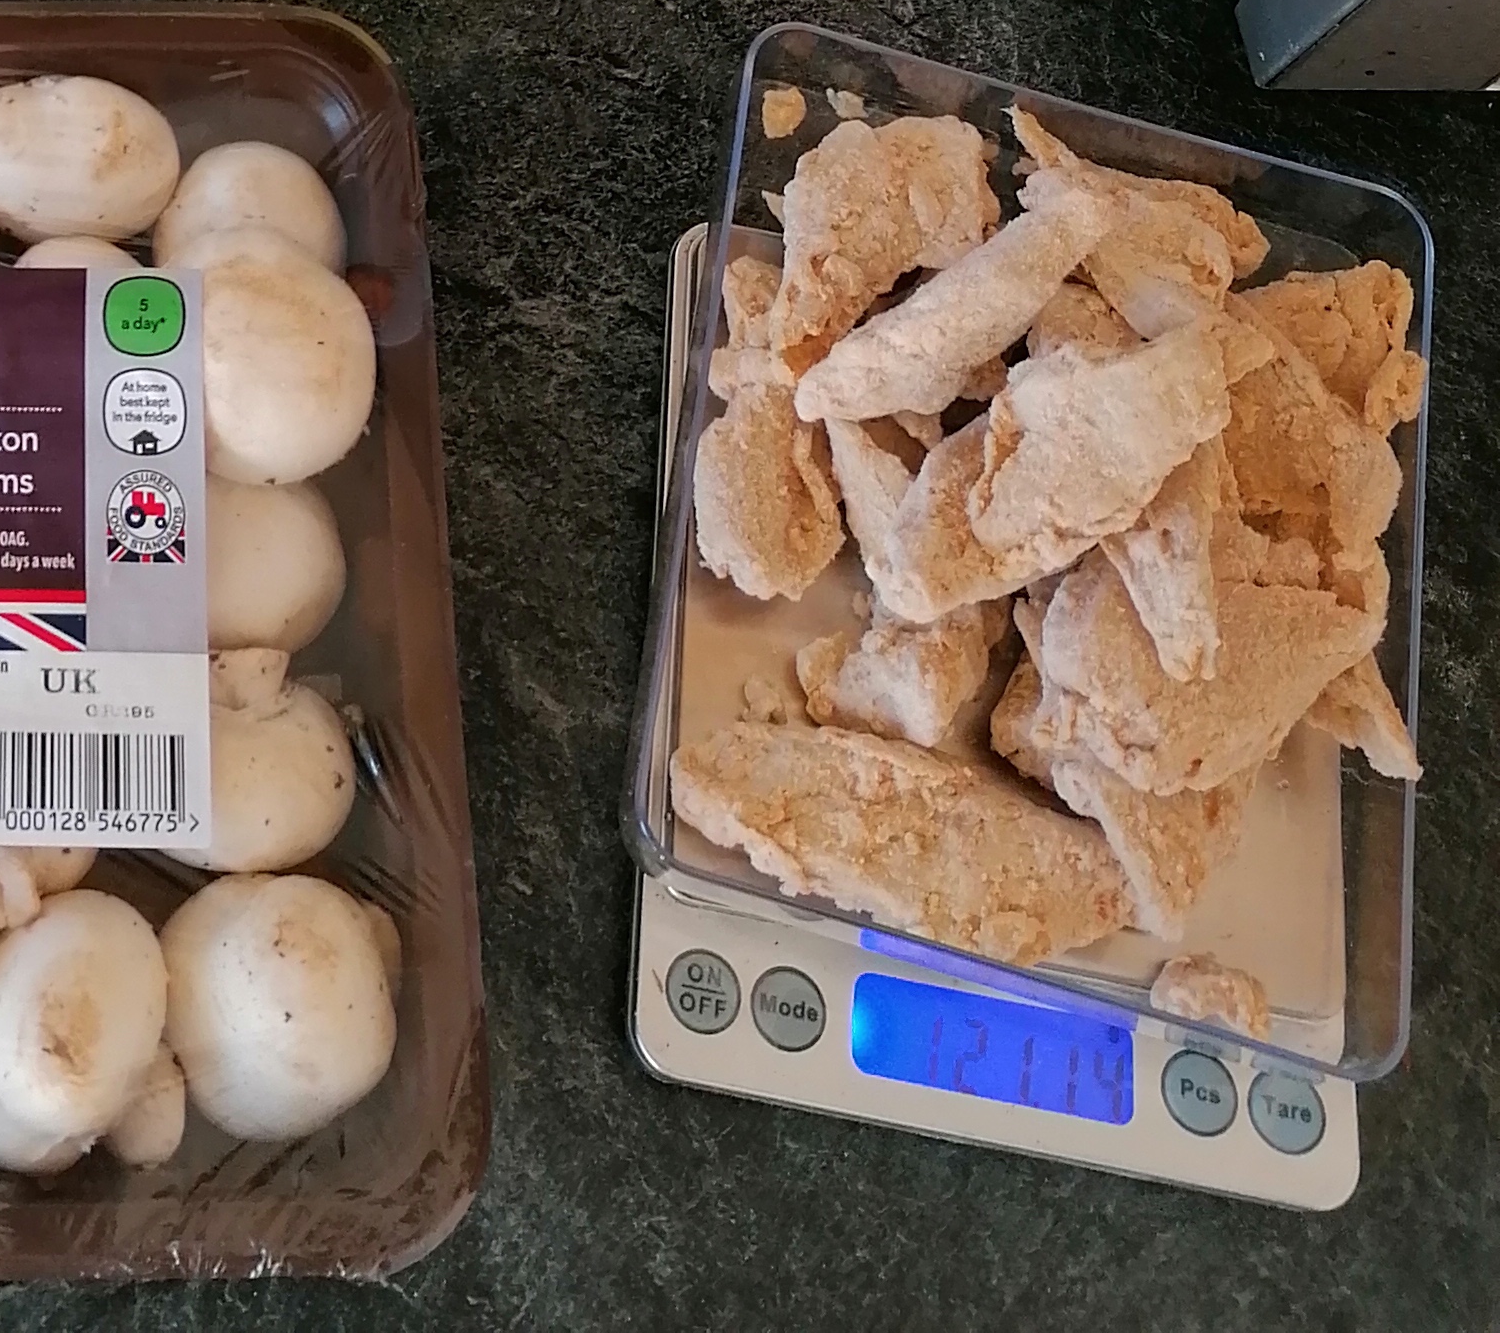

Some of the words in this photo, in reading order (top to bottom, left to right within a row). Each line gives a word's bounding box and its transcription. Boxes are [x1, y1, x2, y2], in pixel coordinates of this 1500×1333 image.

[139, 298, 149, 312] 5
[121, 319, 130, 330] a
[121, 381, 134, 392] At
[137, 381, 167, 392] home
[120, 397, 144, 407] best
[146, 397, 170, 412] kept
[125, 411, 142, 422] the
[145, 411, 178, 425] fridge
[120, 473, 172, 494] ASSURED
[109, 506, 128, 541] FOOD
[131, 506, 184, 551] STANDARDS
[1, 552, 30, 571] days
[32, 556, 40, 568] a
[42, 552, 76, 569] week
[40, 667, 99, 694] UK
[5, 812, 87, 832] 000128
[98, 812, 178, 833] 546775
[687, 962, 722, 987] ON
[679, 991, 727, 1019] OFF
[759, 992, 819, 1022] Mode
[1179, 1077, 1222, 1106] Pcs
[1259, 1092, 1313, 1124] Tare
